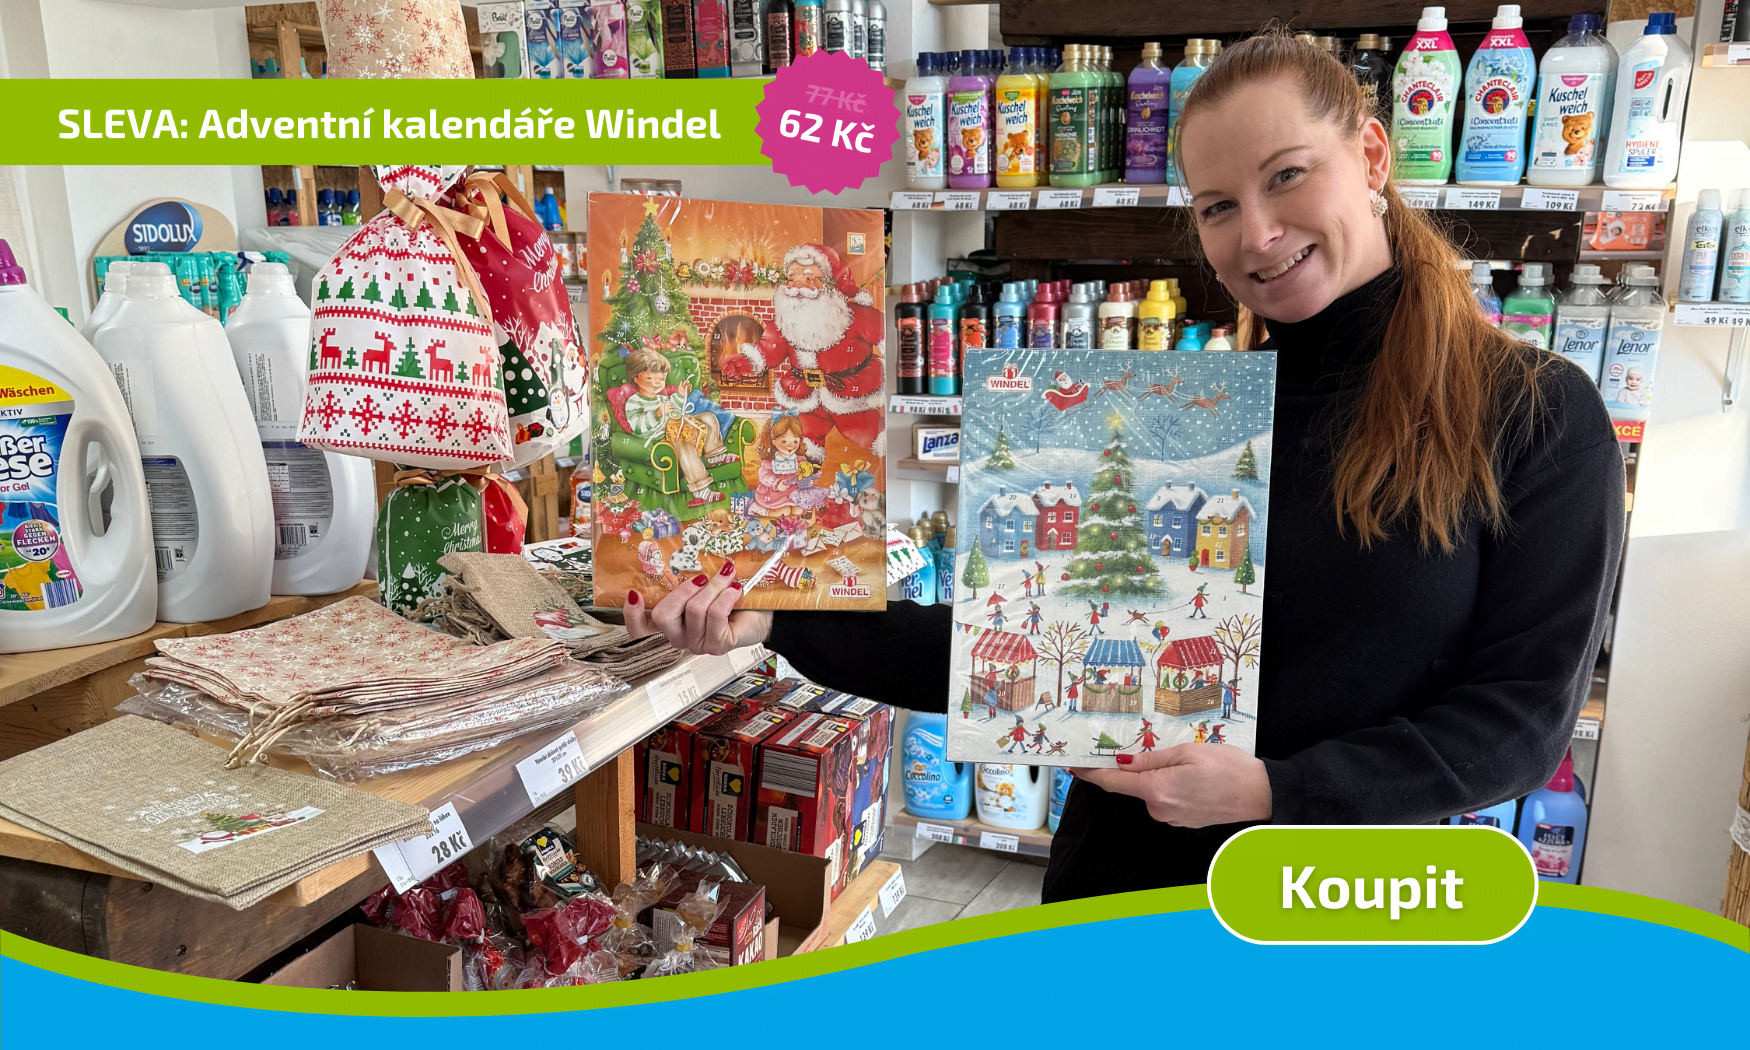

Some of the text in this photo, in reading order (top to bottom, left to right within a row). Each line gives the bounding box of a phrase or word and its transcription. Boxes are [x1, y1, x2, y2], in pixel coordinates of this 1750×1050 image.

[1416, 40, 1438, 49] XXL
[1490, 38, 1514, 47] XXL
[1401, 80, 1444, 103] CHANTECLAIR
[1475, 78, 1519, 102] CHANTECLAIR
[1548, 87, 1588, 102] Kuschel
[907, 104, 933, 118] Kuschel
[951, 101, 980, 114] Kuschel
[997, 99, 1026, 115] Kuschel
[1560, 101, 1588, 115] weich
[914, 116, 935, 128] weich
[959, 114, 982, 126] weich
[1005, 113, 1028, 126] weich
[912, 201, 929, 209] 68 Kč
[1019, 201, 1027, 209] Kč
[1059, 200, 1078, 208] 68 Kč
[1116, 197, 1136, 205] 68 Kč
[1545, 201, 1574, 210] 109 Kč
[132, 223, 197, 245] SIDOLUX
[1696, 225, 1718, 234] elkos
[519, 231, 553, 270] Merry
[1704, 317, 1729, 325] 49 Kč
[1731, 317, 1743, 325] 49
[1562, 339, 1599, 353] Lenor
[1616, 339, 1654, 355] Lenor
[990, 380, 1030, 389] WINDEL
[0, 385, 55, 399] Wäschen
[0, 408, 23, 417] KTIV
[922, 432, 959, 454] Lanza
[12, 482, 30, 492] Gel
[442, 519, 478, 540] Merry
[16, 535, 56, 546] FLECKEN
[831, 588, 870, 596] WINDEL
[905, 582, 922, 599] nel
[751, 647, 760, 660] 28
[677, 685, 700, 706] 15 Kč
[558, 756, 586, 783] 39 Kč
[905, 769, 941, 782] Coccolino
[979, 764, 1011, 776] Coccolino
[770, 812, 778, 847] OKOLADEN
[931, 833, 943, 841] 208
[1537, 838, 1571, 846] AZZURRA
[431, 830, 467, 864] 28 Kč
[995, 842, 1007, 850] 208
[738, 931, 763, 966] KAKAO
